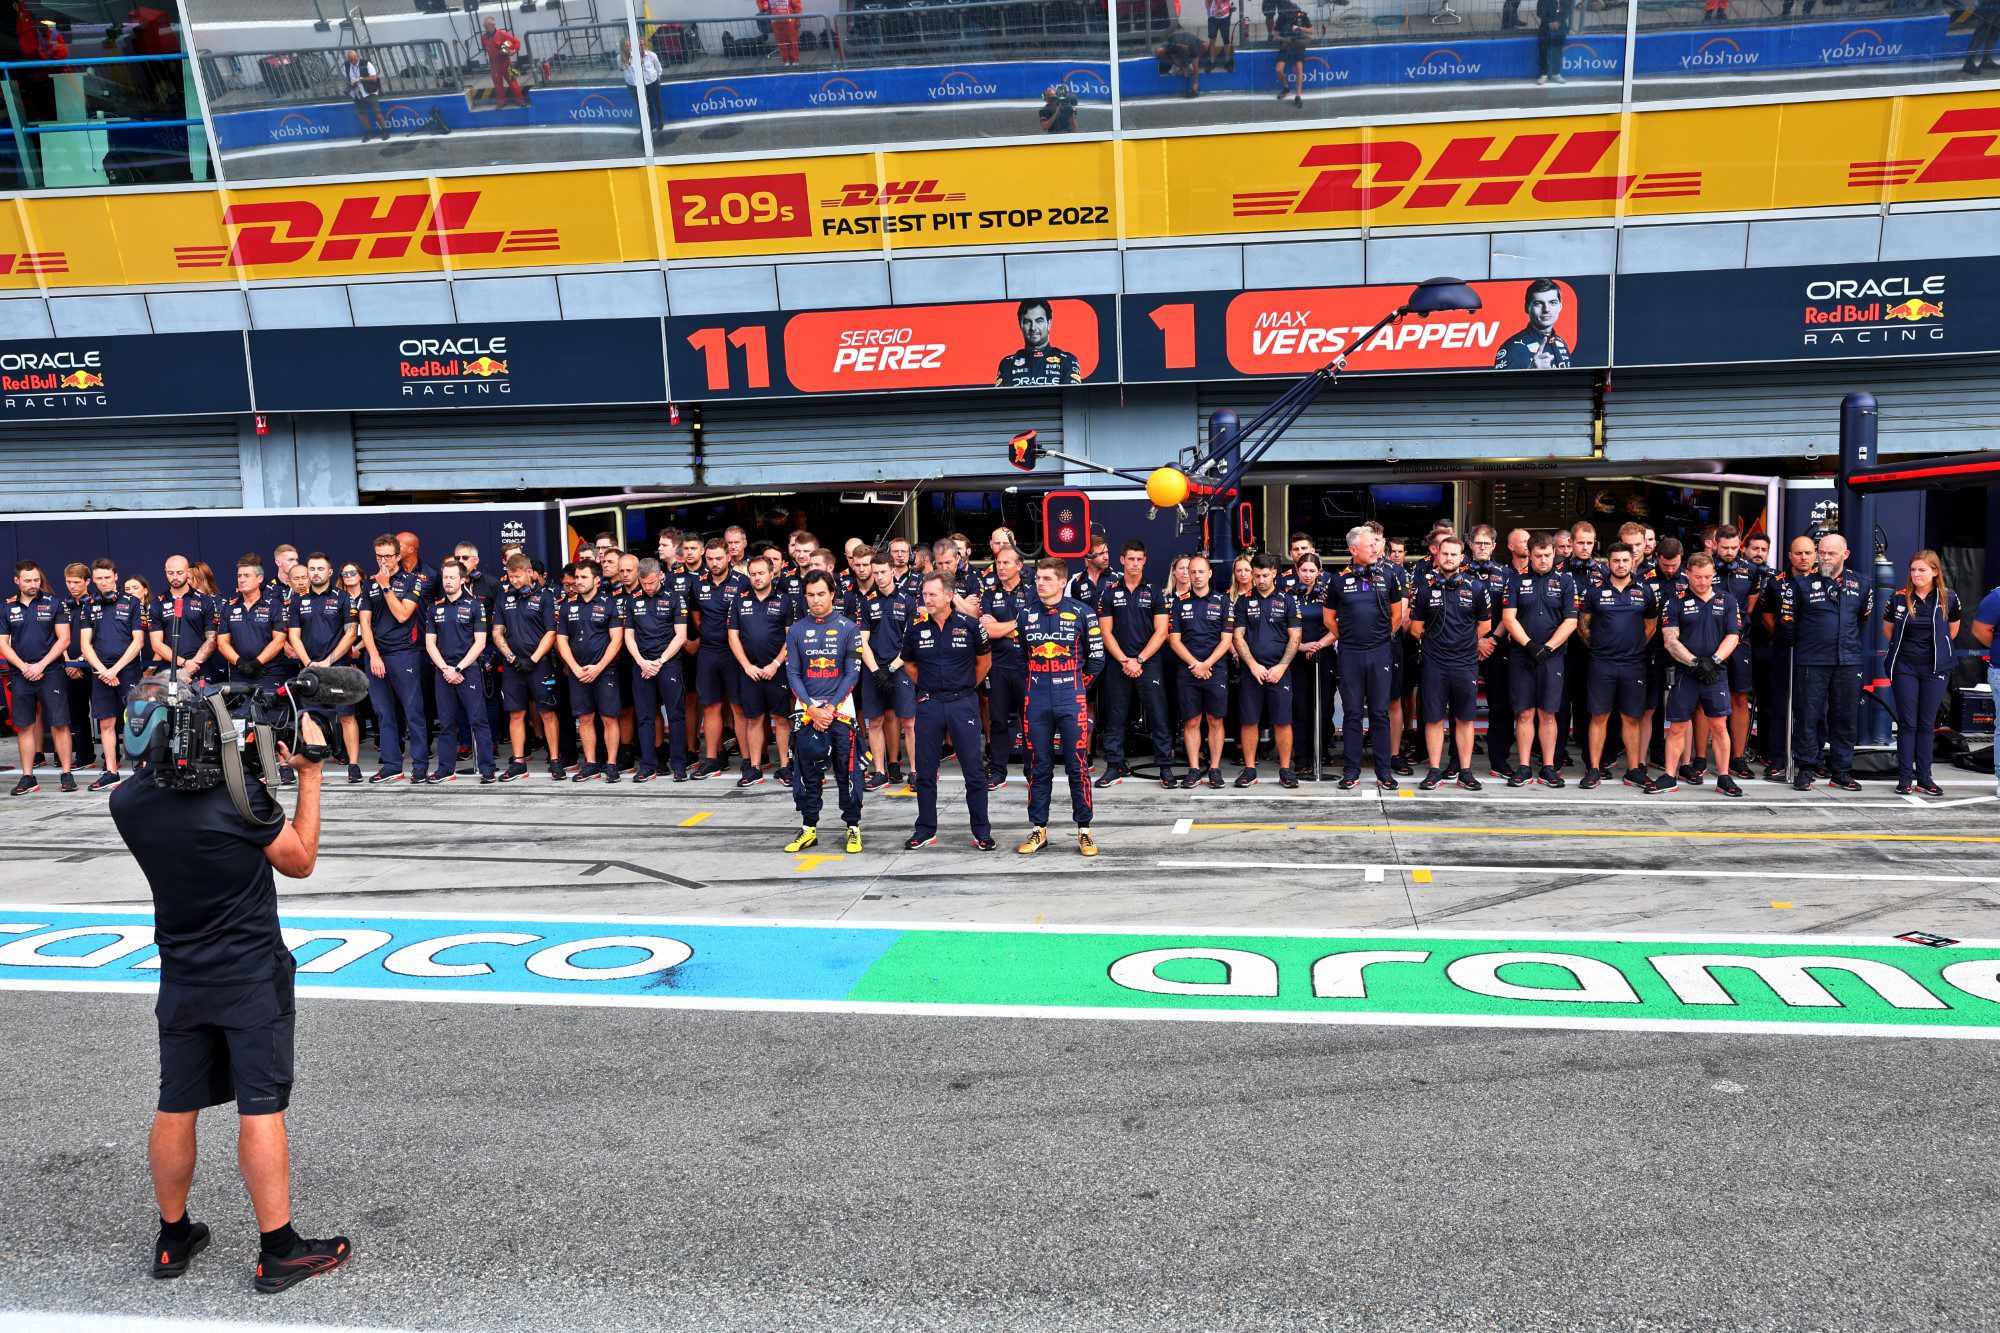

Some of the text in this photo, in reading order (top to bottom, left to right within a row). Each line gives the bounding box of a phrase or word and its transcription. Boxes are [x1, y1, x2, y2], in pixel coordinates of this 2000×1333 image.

[1293, 131, 1638, 214] DHL
[840, 180, 949, 207] DHL
[681, 191, 796, 227] 2.09s
[222, 191, 505, 267] DHL
[822, 206, 1109, 236] FASTEST PIT STOP 2022
[1806, 275, 1946, 300] ORACLE
[1254, 310, 1312, 329] MAX
[1805, 303, 1880, 324] Red Bull
[399, 336, 507, 357] ORACLE
[838, 327, 913, 347] SERGIO
[1148, 303, 1197, 369] 1
[1252, 321, 1500, 356] VERSTAPPEN
[1804, 328, 1944, 345] RACING
[0, 350, 102, 371] ORACLE
[686, 325, 770, 390] 11
[832, 343, 947, 373] PEREZ
[400, 360, 459, 377] Red Bull
[2, 373, 58, 391] Red Bull
[402, 383, 511, 396] RACING
[5, 395, 107, 409] RACING
[670, 405, 680, 418] 16
[256, 415, 268, 429] 17
[1026, 632, 1075, 641] ORACLE
[807, 667, 839, 678] Red Bull
[1029, 658, 1076, 672] Red Bull
